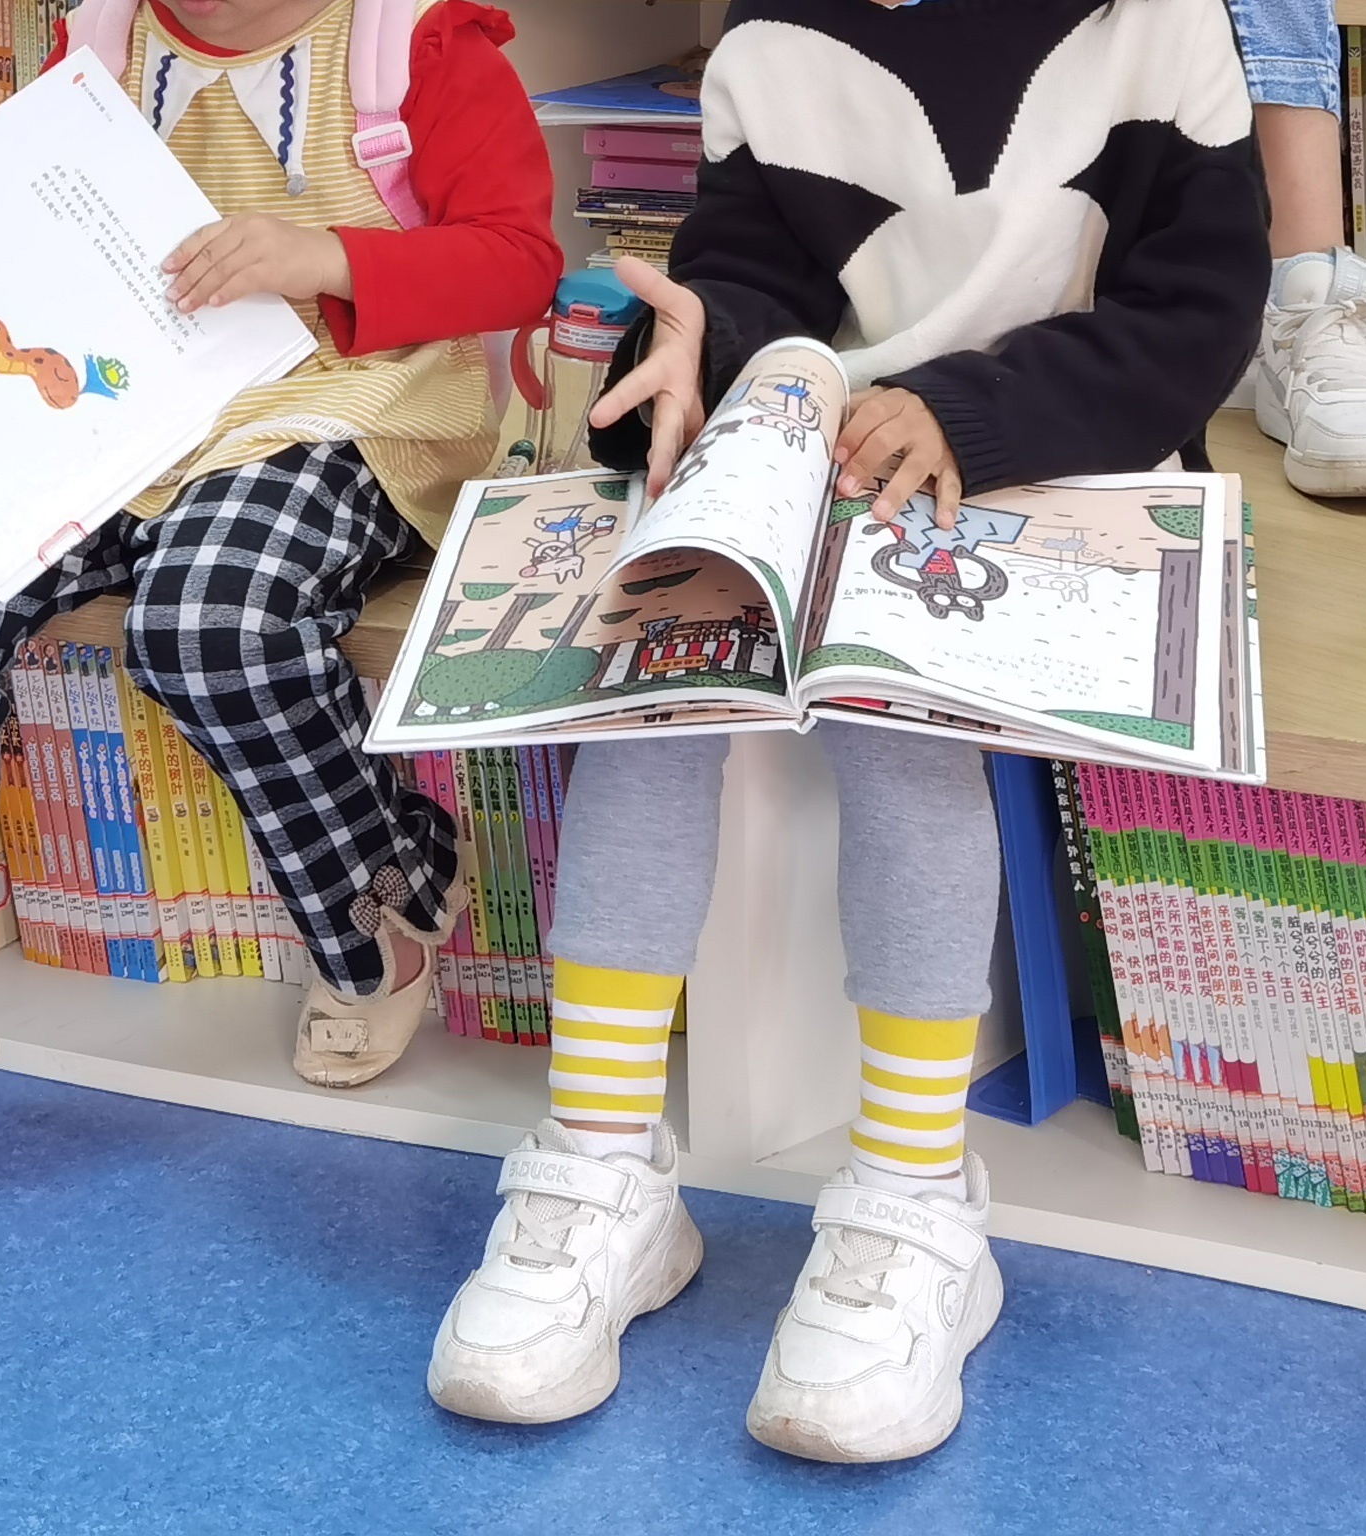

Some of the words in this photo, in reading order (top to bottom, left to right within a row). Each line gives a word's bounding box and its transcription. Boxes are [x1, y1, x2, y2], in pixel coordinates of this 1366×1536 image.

[1149, 891, 1177, 993] 无所不能的朋友
[1166, 895, 1194, 997] 无所不能的朋友
[1184, 896, 1213, 998] 无所不能的朋友
[1199, 905, 1229, 1007] 亲密无间的朋友
[1217, 904, 1247, 1007] 亲密无间的朋友
[1233, 906, 1258, 995] 等到下个生日
[1252, 910, 1277, 999] 等到下个生日
[1270, 916, 1295, 1004] 等到下个生日
[1287, 915, 1314, 1004] 脏兮兮的公主
[1303, 921, 1330, 1010] 脏兮兮的公主
[1321, 921, 1346, 1011] 脏兮兮的公主
[1335, 927, 1362, 1016] 奶奶的百宝箱
[853, 1195, 937, 1239] B.DUCK
